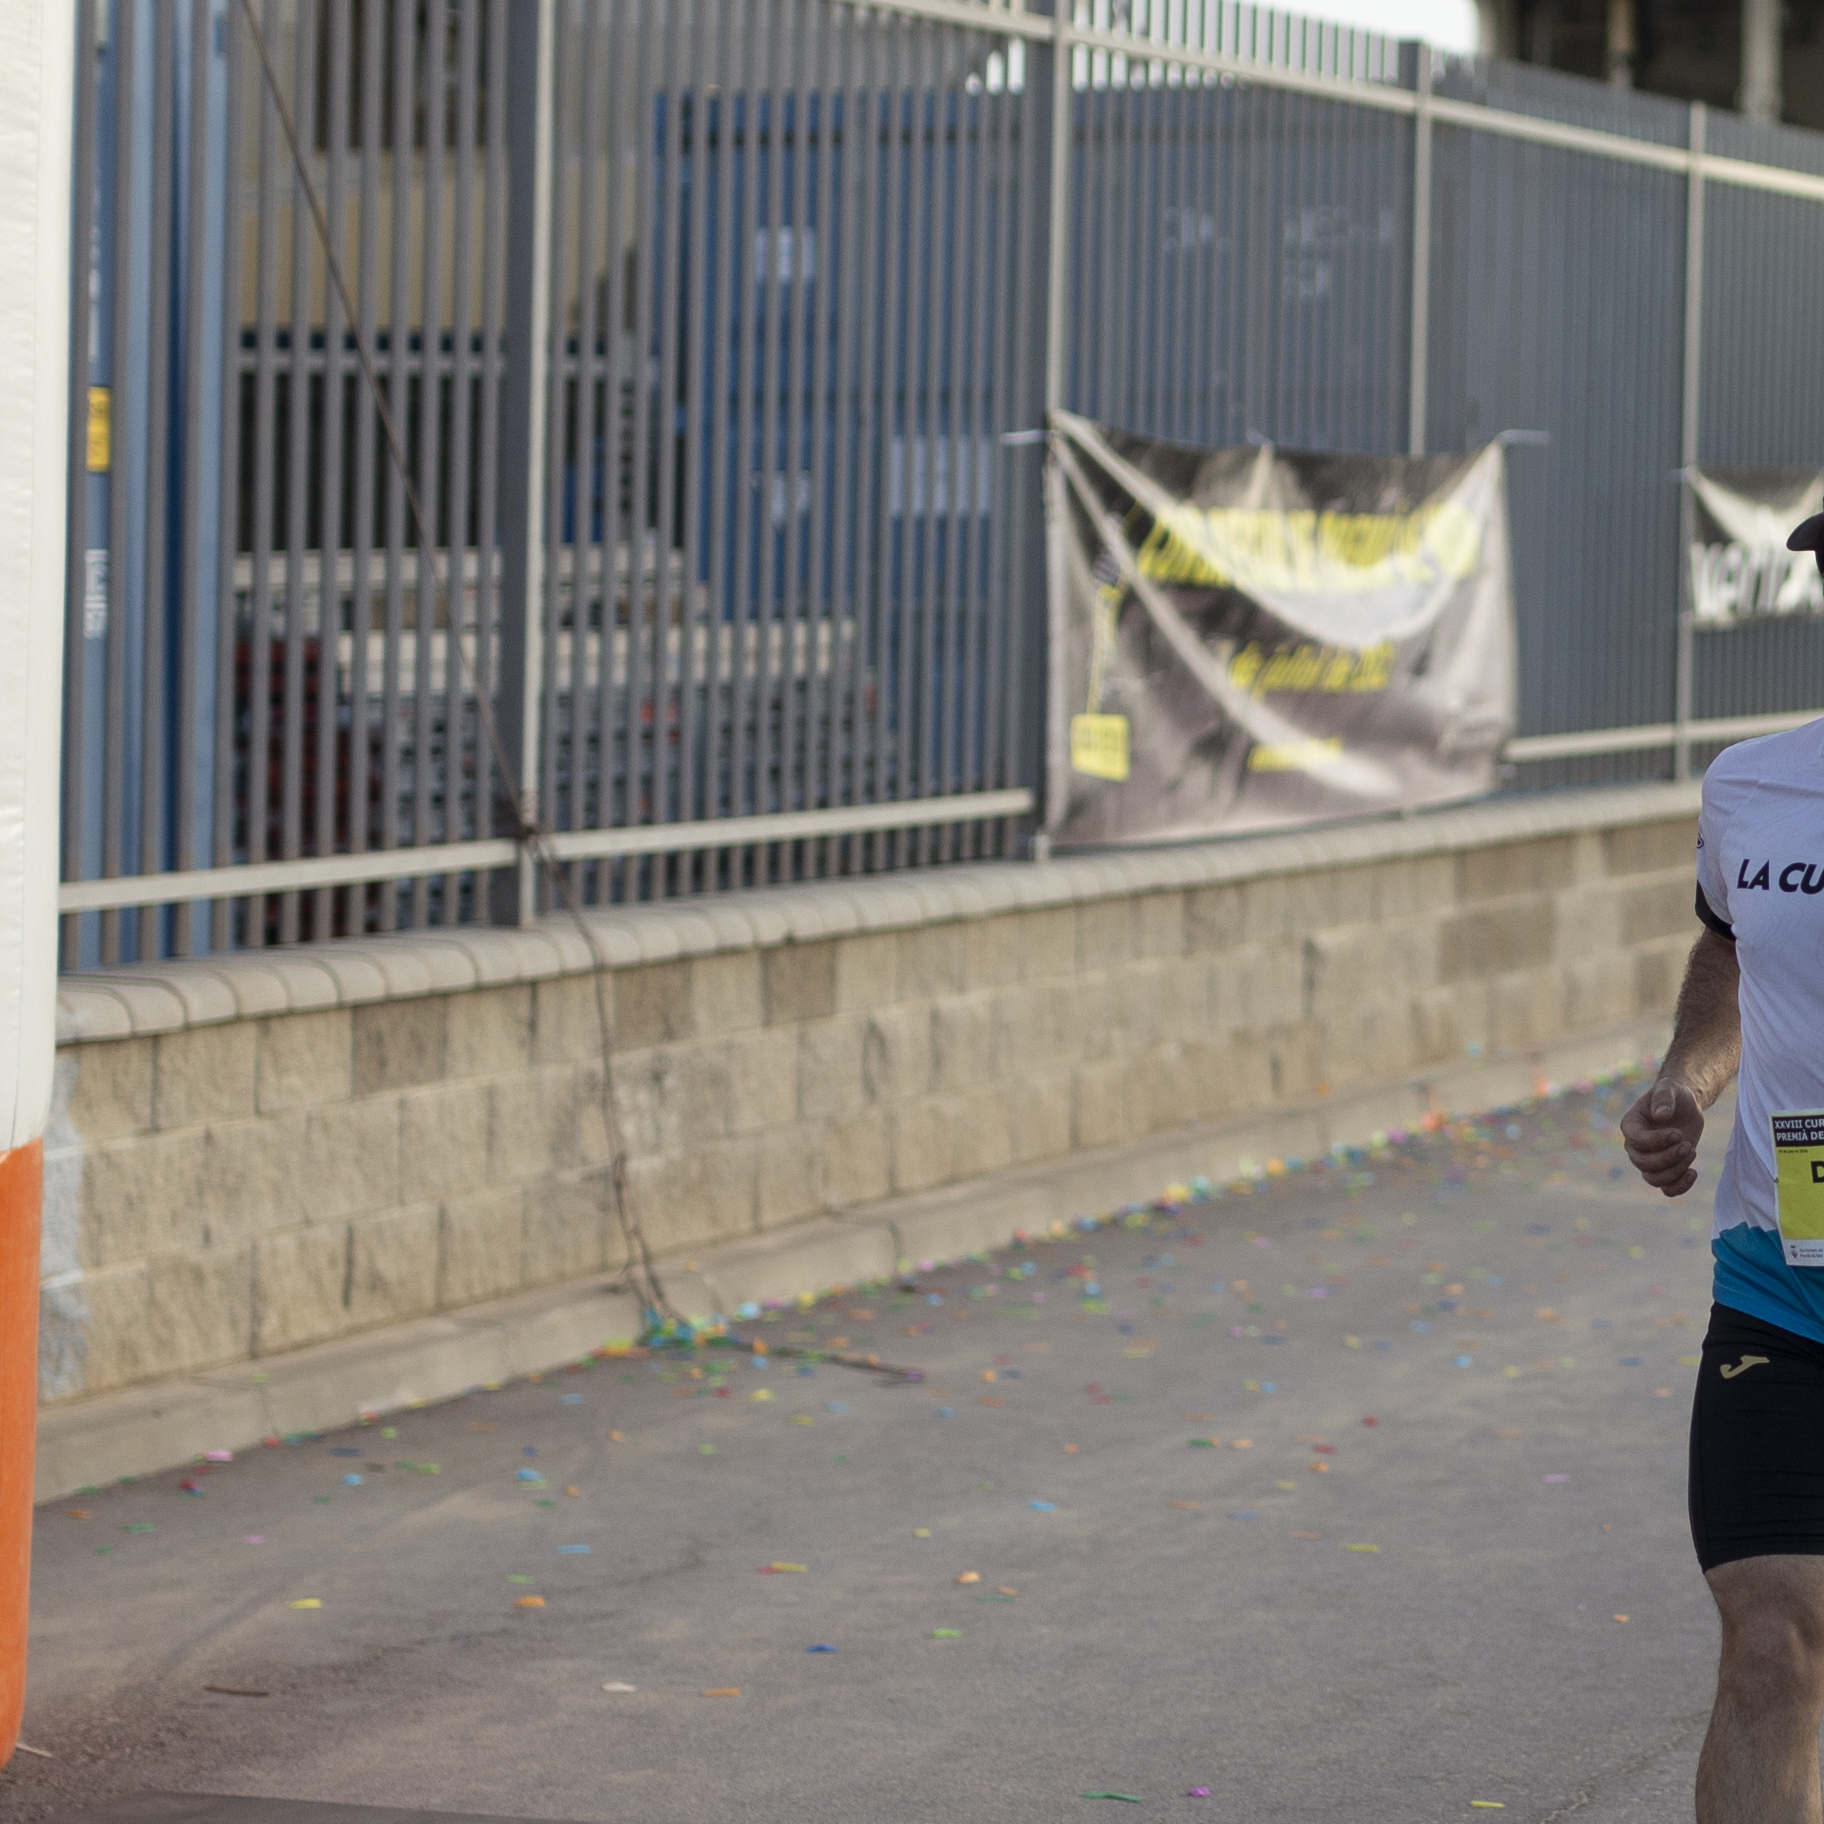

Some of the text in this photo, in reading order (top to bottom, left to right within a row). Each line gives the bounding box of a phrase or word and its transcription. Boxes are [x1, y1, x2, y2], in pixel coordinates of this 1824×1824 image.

[1737, 859, 1770, 891] LA
[1775, 1119, 1803, 1129] XXVIII
[1776, 1129, 1809, 1142] PREMIÀ
[1810, 1131, 1824, 1141] DE
